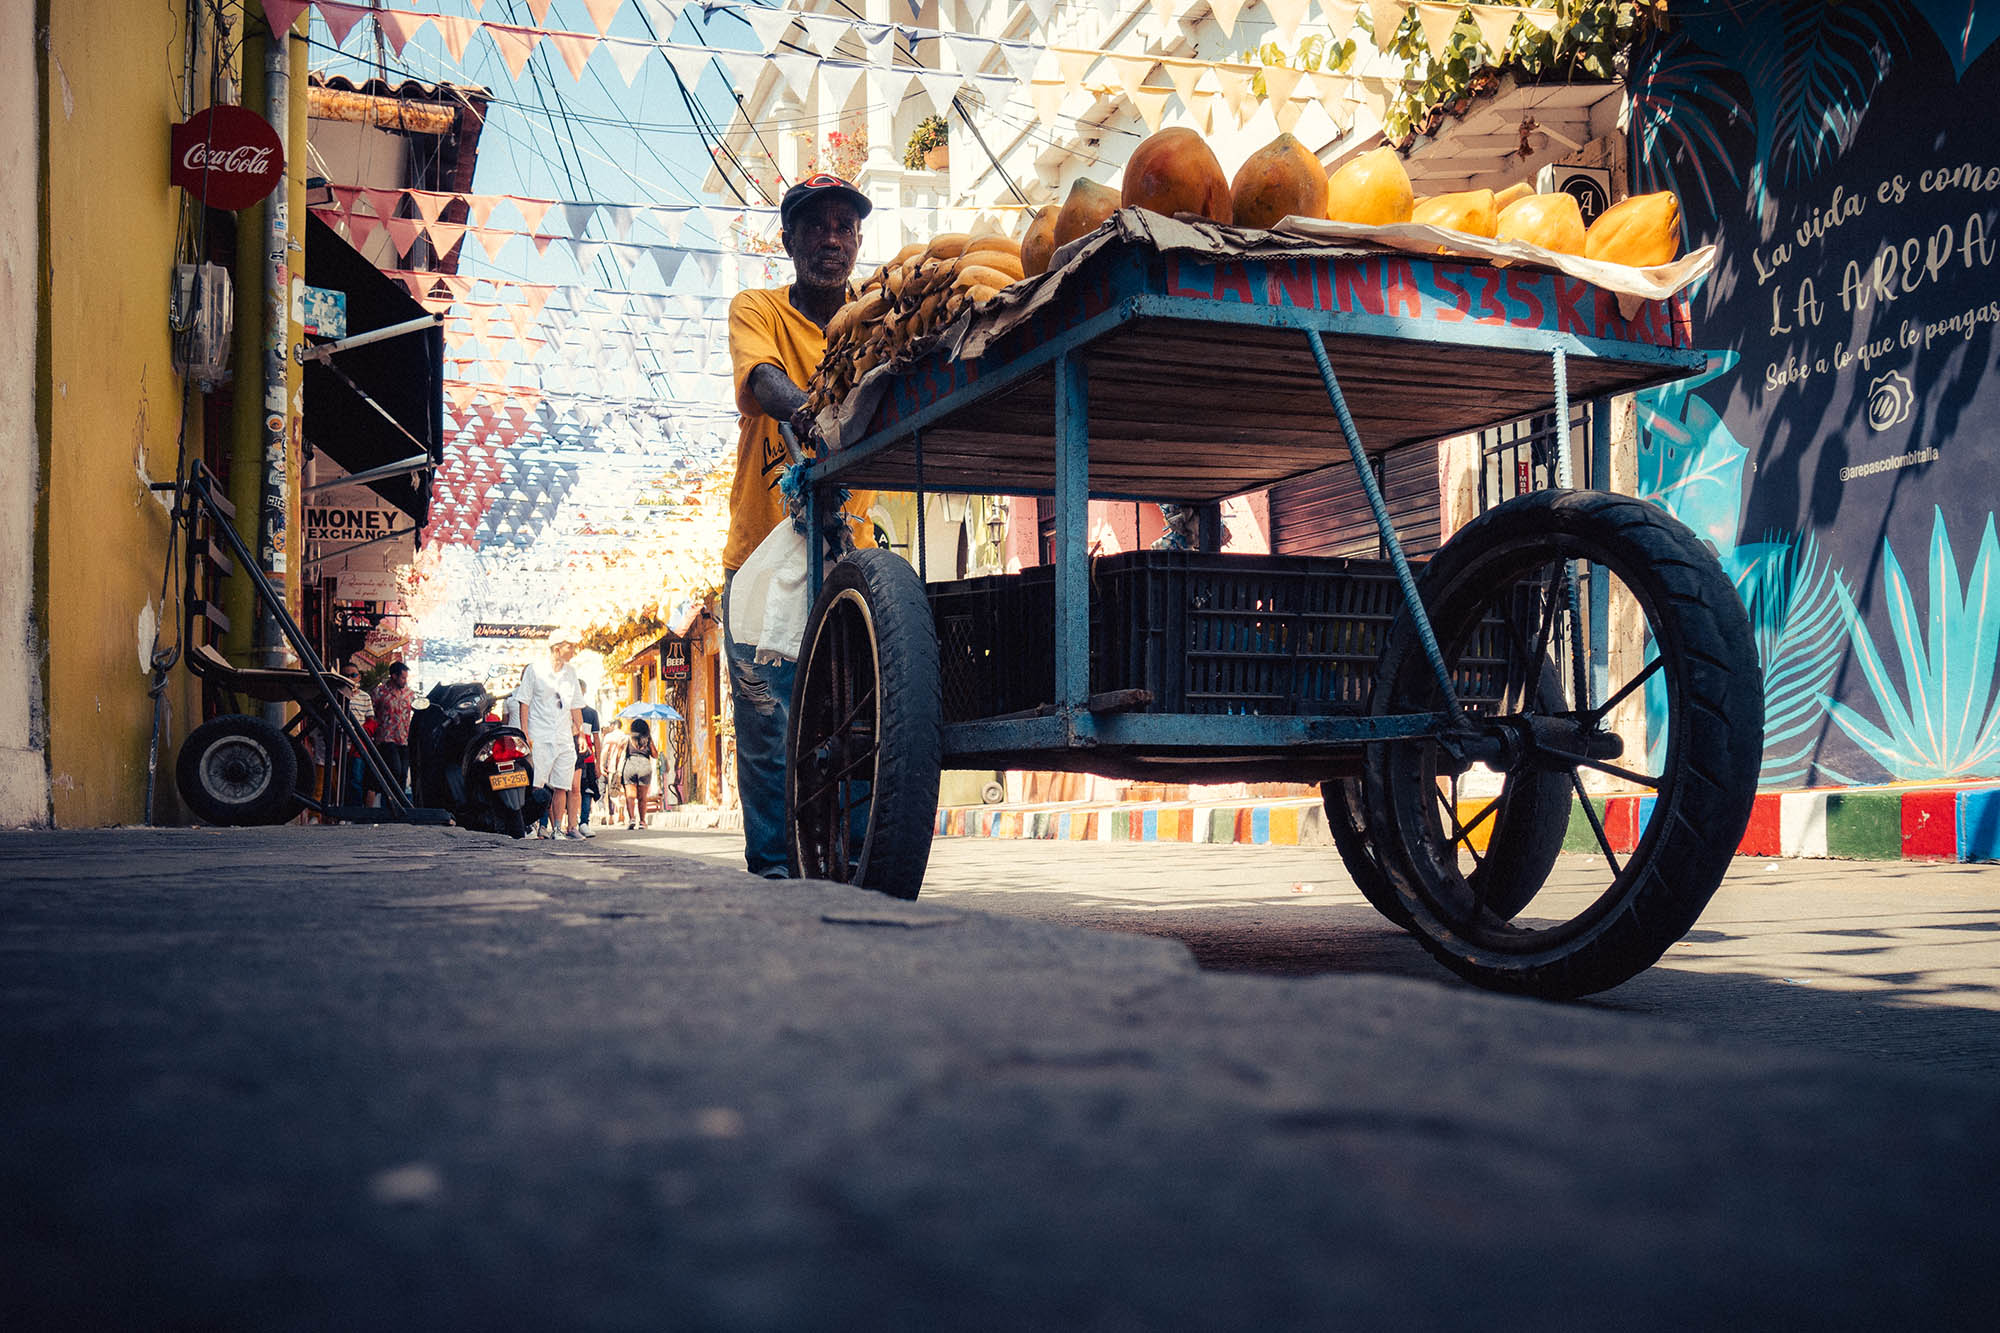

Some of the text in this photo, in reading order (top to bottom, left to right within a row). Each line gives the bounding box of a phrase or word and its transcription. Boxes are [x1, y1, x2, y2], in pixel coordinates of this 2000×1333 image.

[183, 142, 274, 175] Coca-Cola
[1752, 162, 2000, 286] La vida es como
[1770, 212, 1996, 337] LA AREPA
[1766, 300, 2000, 391] Sabe a lo que le pongas
[307, 509, 399, 529] MONEY
[307, 528, 399, 541] EXCHANG
[667, 658, 685, 667] BEER
